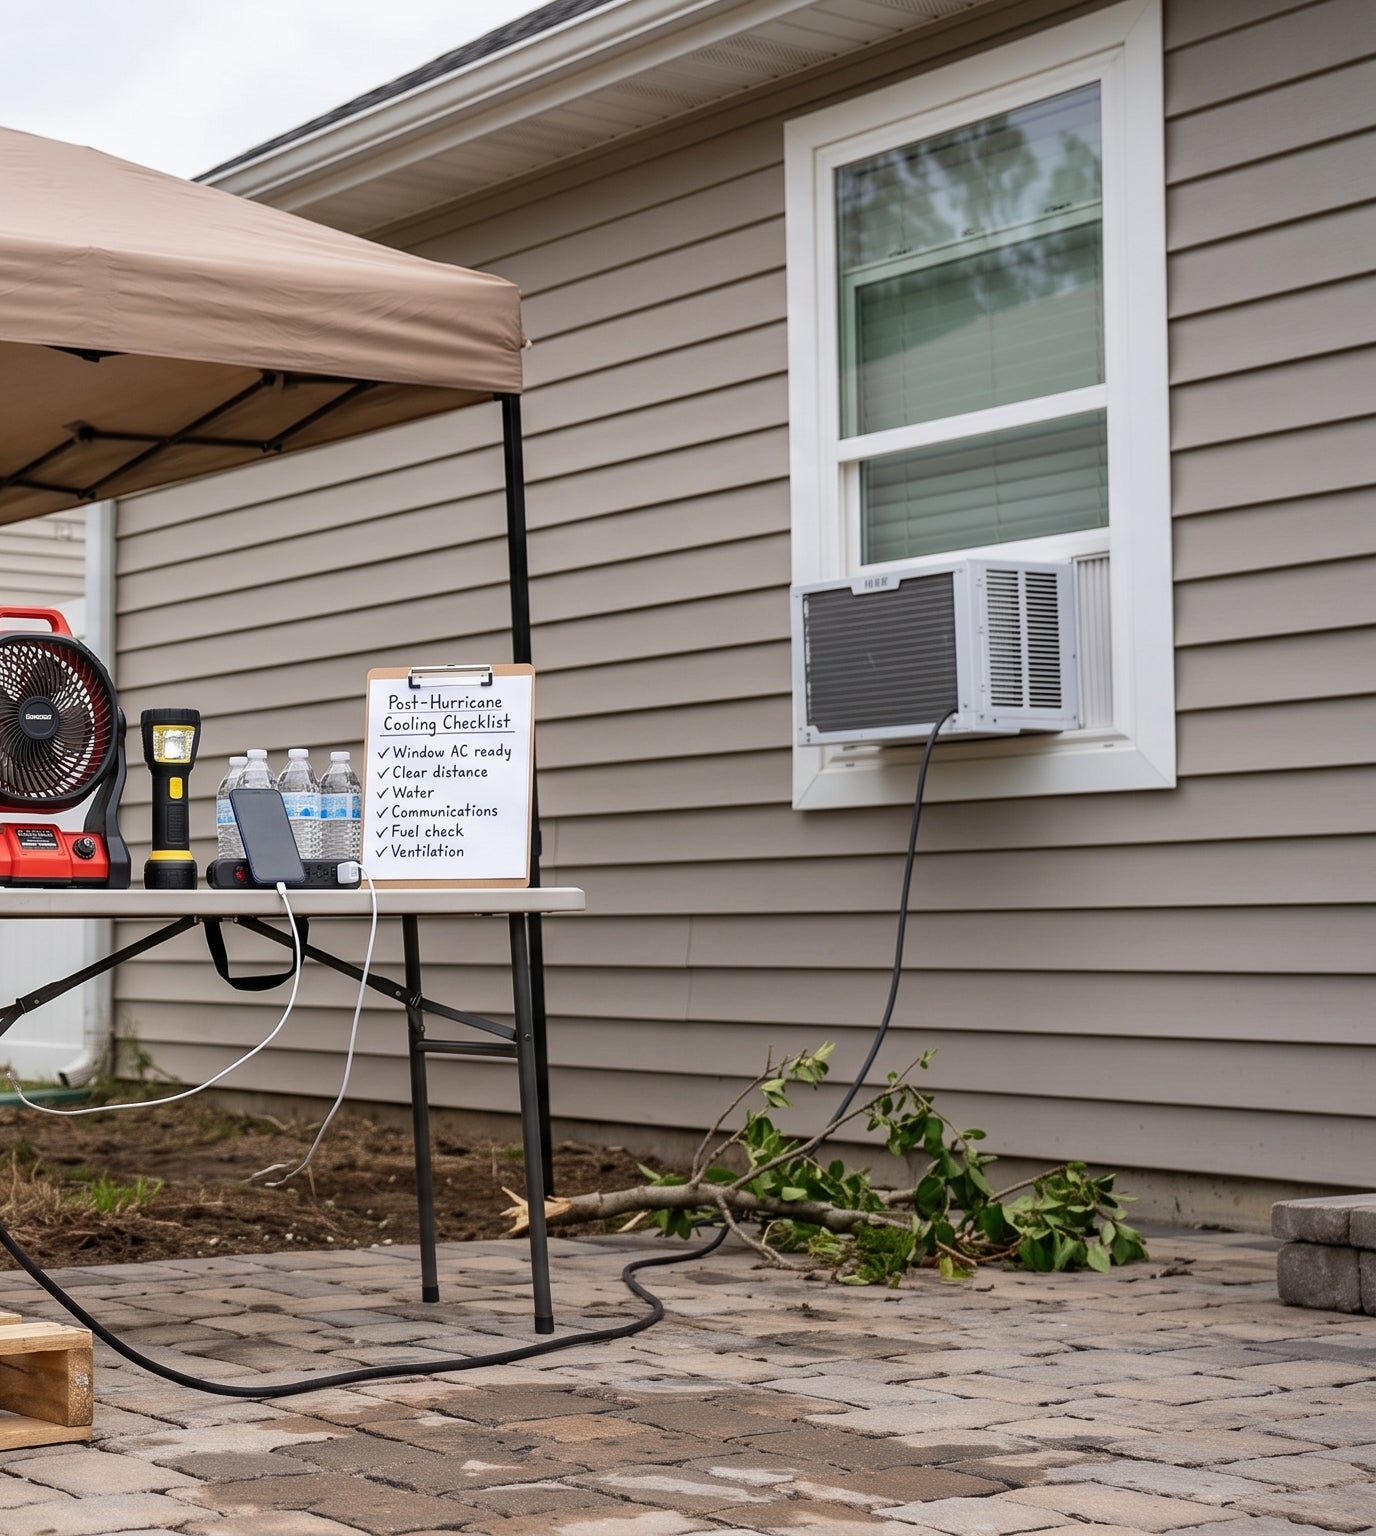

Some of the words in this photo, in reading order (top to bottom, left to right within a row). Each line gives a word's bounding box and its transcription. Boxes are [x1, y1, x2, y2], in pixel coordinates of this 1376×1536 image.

[388, 694, 502, 710] Post-Hurricane
[383, 716, 436, 736] Cooling
[443, 713, 511, 730] Checklist
[393, 746, 445, 759] Window
[450, 744, 468, 758] AC
[474, 744, 512, 761] ready
[392, 766, 428, 779] Clear
[432, 765, 489, 779] distance
[392, 786, 435, 799] Water
[391, 803, 498, 818] Communications
[391, 824, 419, 838] Fuel
[425, 823, 464, 838] check
[391, 844, 464, 858] Ventilation
